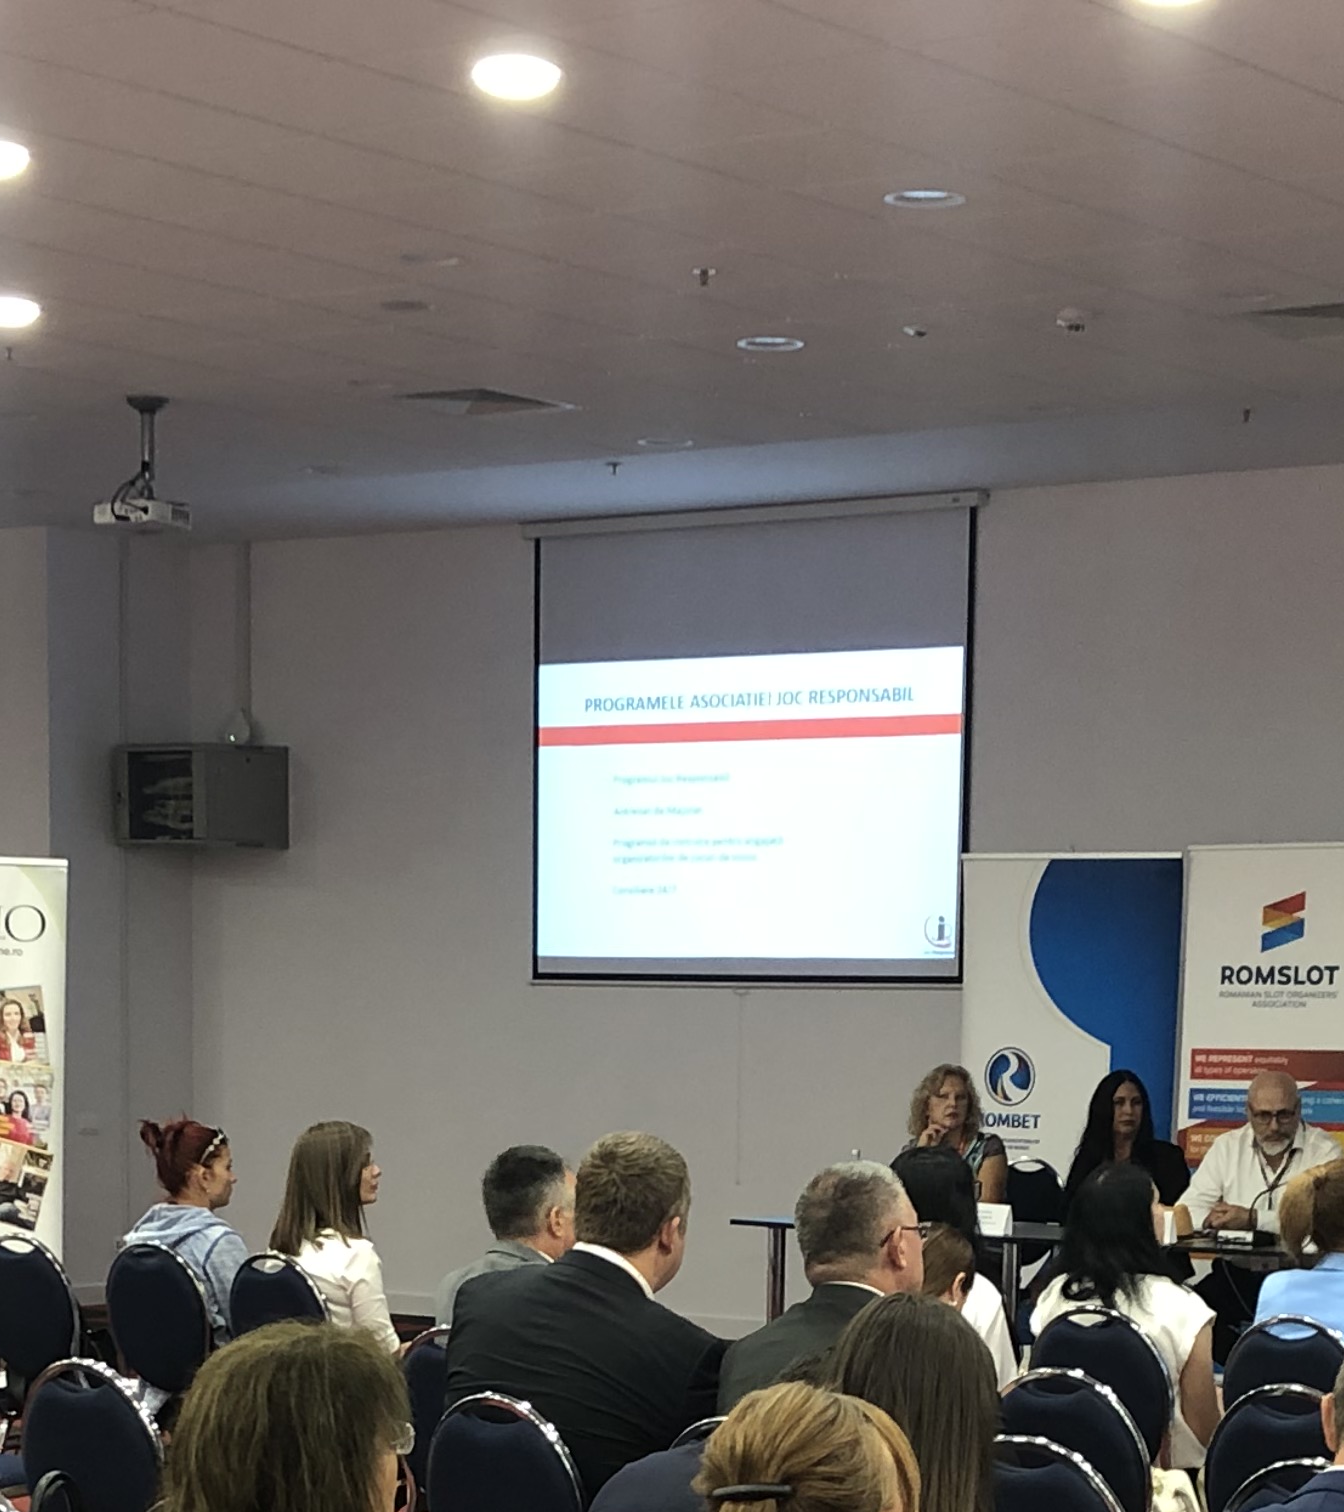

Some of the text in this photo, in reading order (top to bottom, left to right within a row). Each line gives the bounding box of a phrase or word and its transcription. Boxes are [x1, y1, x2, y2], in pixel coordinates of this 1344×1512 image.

[584, 695, 684, 713] PROGRAMELE
[776, 690, 803, 706] JOC
[808, 687, 914, 705] RESPONSABIL
[1220, 964, 1340, 986] ROMSLOT
